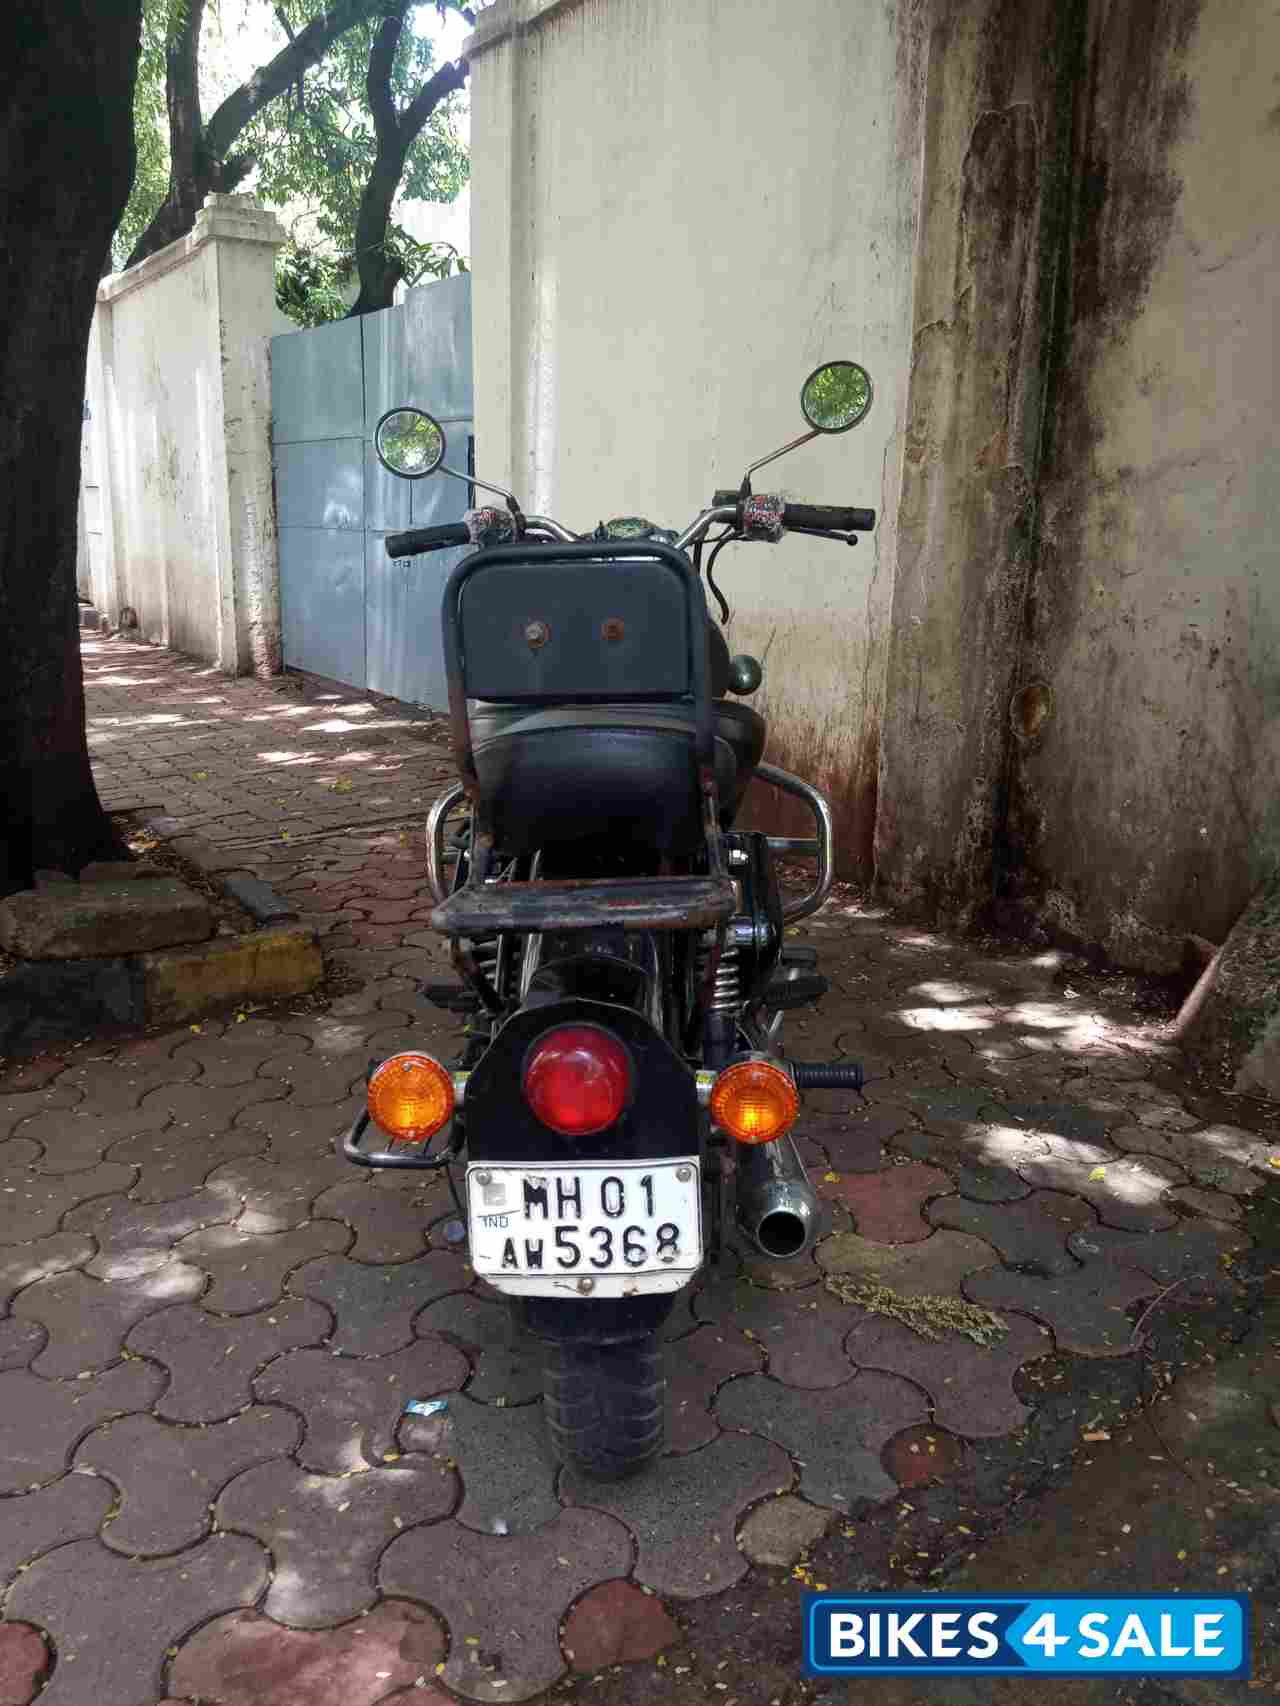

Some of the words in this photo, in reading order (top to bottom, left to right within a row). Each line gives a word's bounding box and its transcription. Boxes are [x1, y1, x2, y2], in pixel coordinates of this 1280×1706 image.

[522, 1175, 582, 1220] MH
[601, 1174, 656, 1218] 01
[554, 1222, 680, 1269] 5368
